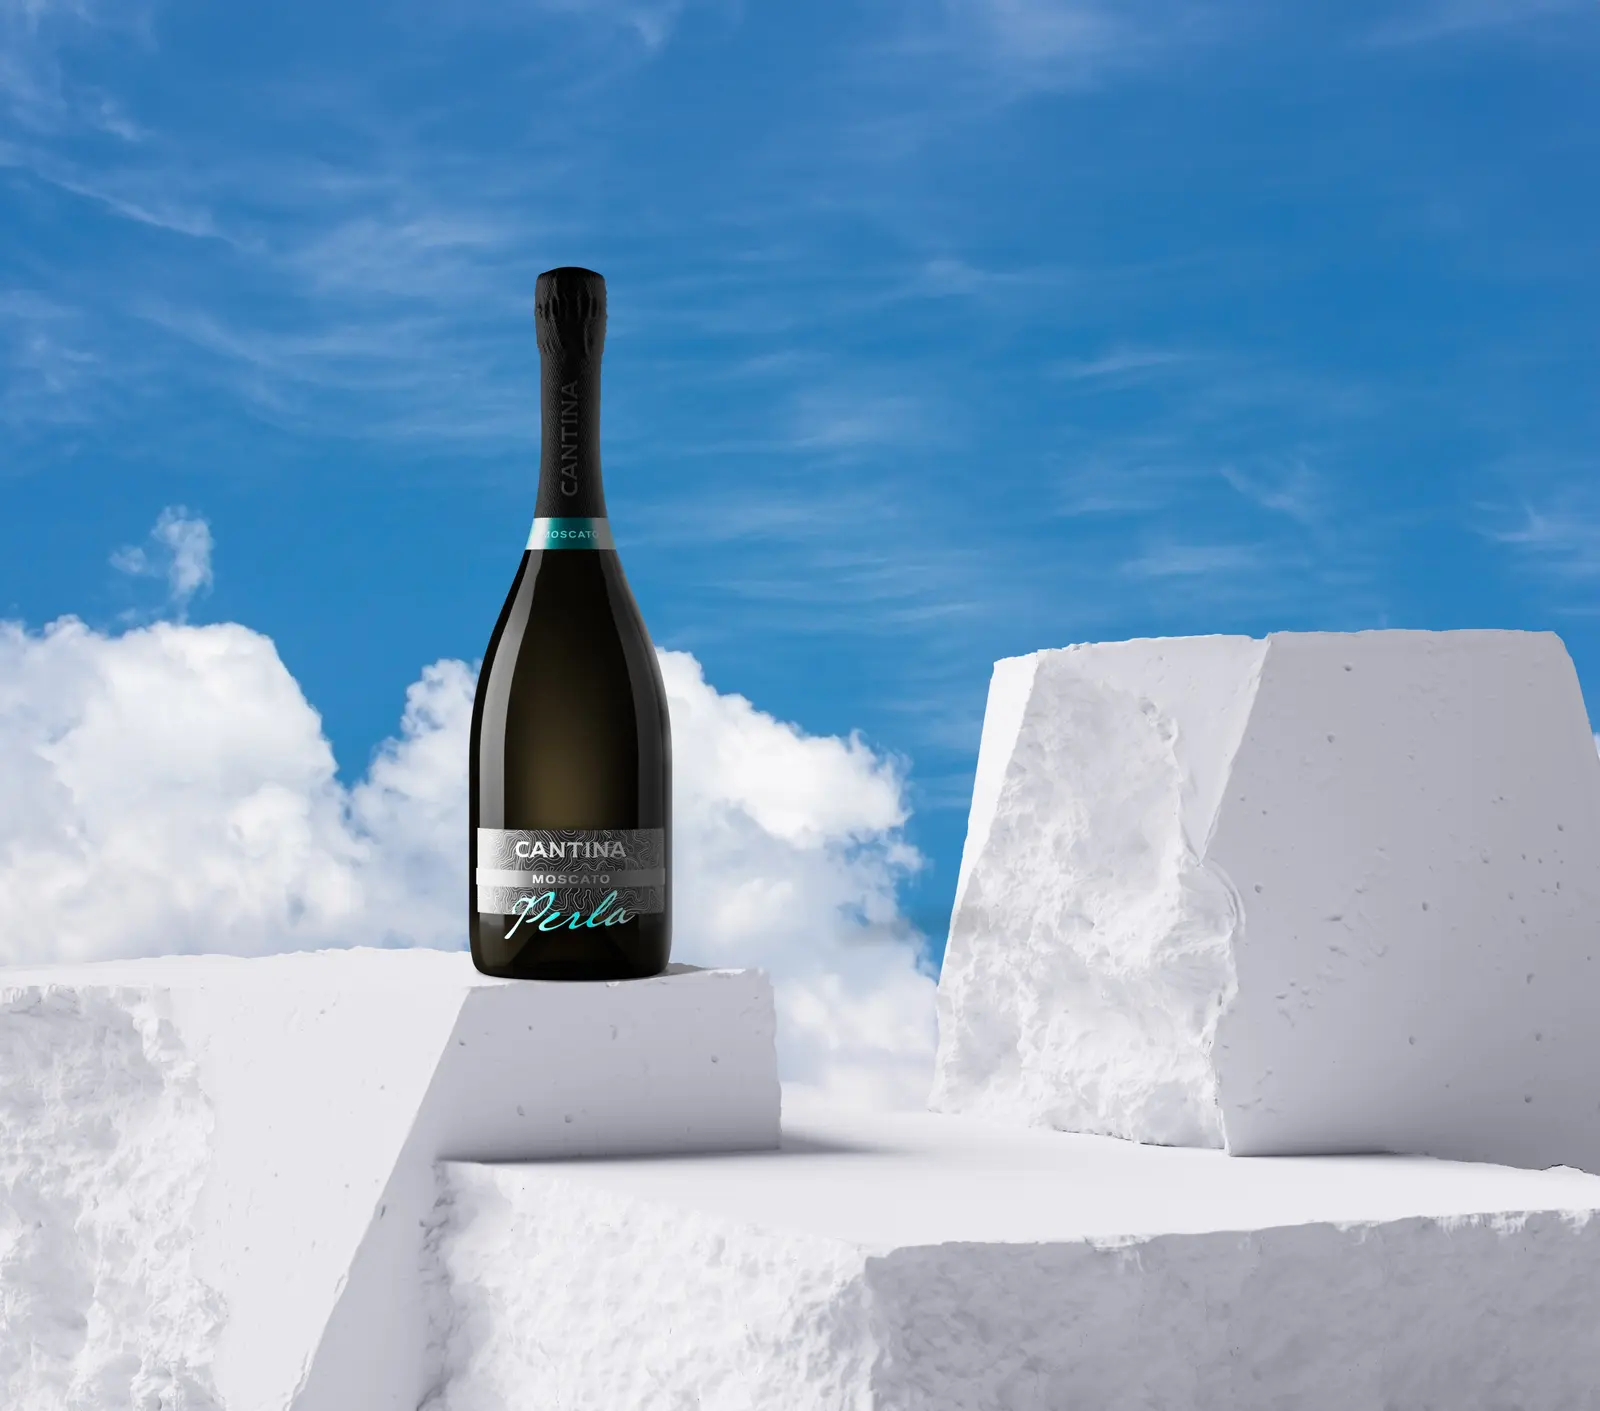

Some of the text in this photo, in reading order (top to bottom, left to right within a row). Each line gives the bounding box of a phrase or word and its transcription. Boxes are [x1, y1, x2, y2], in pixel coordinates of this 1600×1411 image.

[561, 380, 578, 497] CANTINA
[515, 841, 627, 858] CANTINA
[532, 874, 610, 885] MOSCATO
[504, 889, 636, 940] Perla
